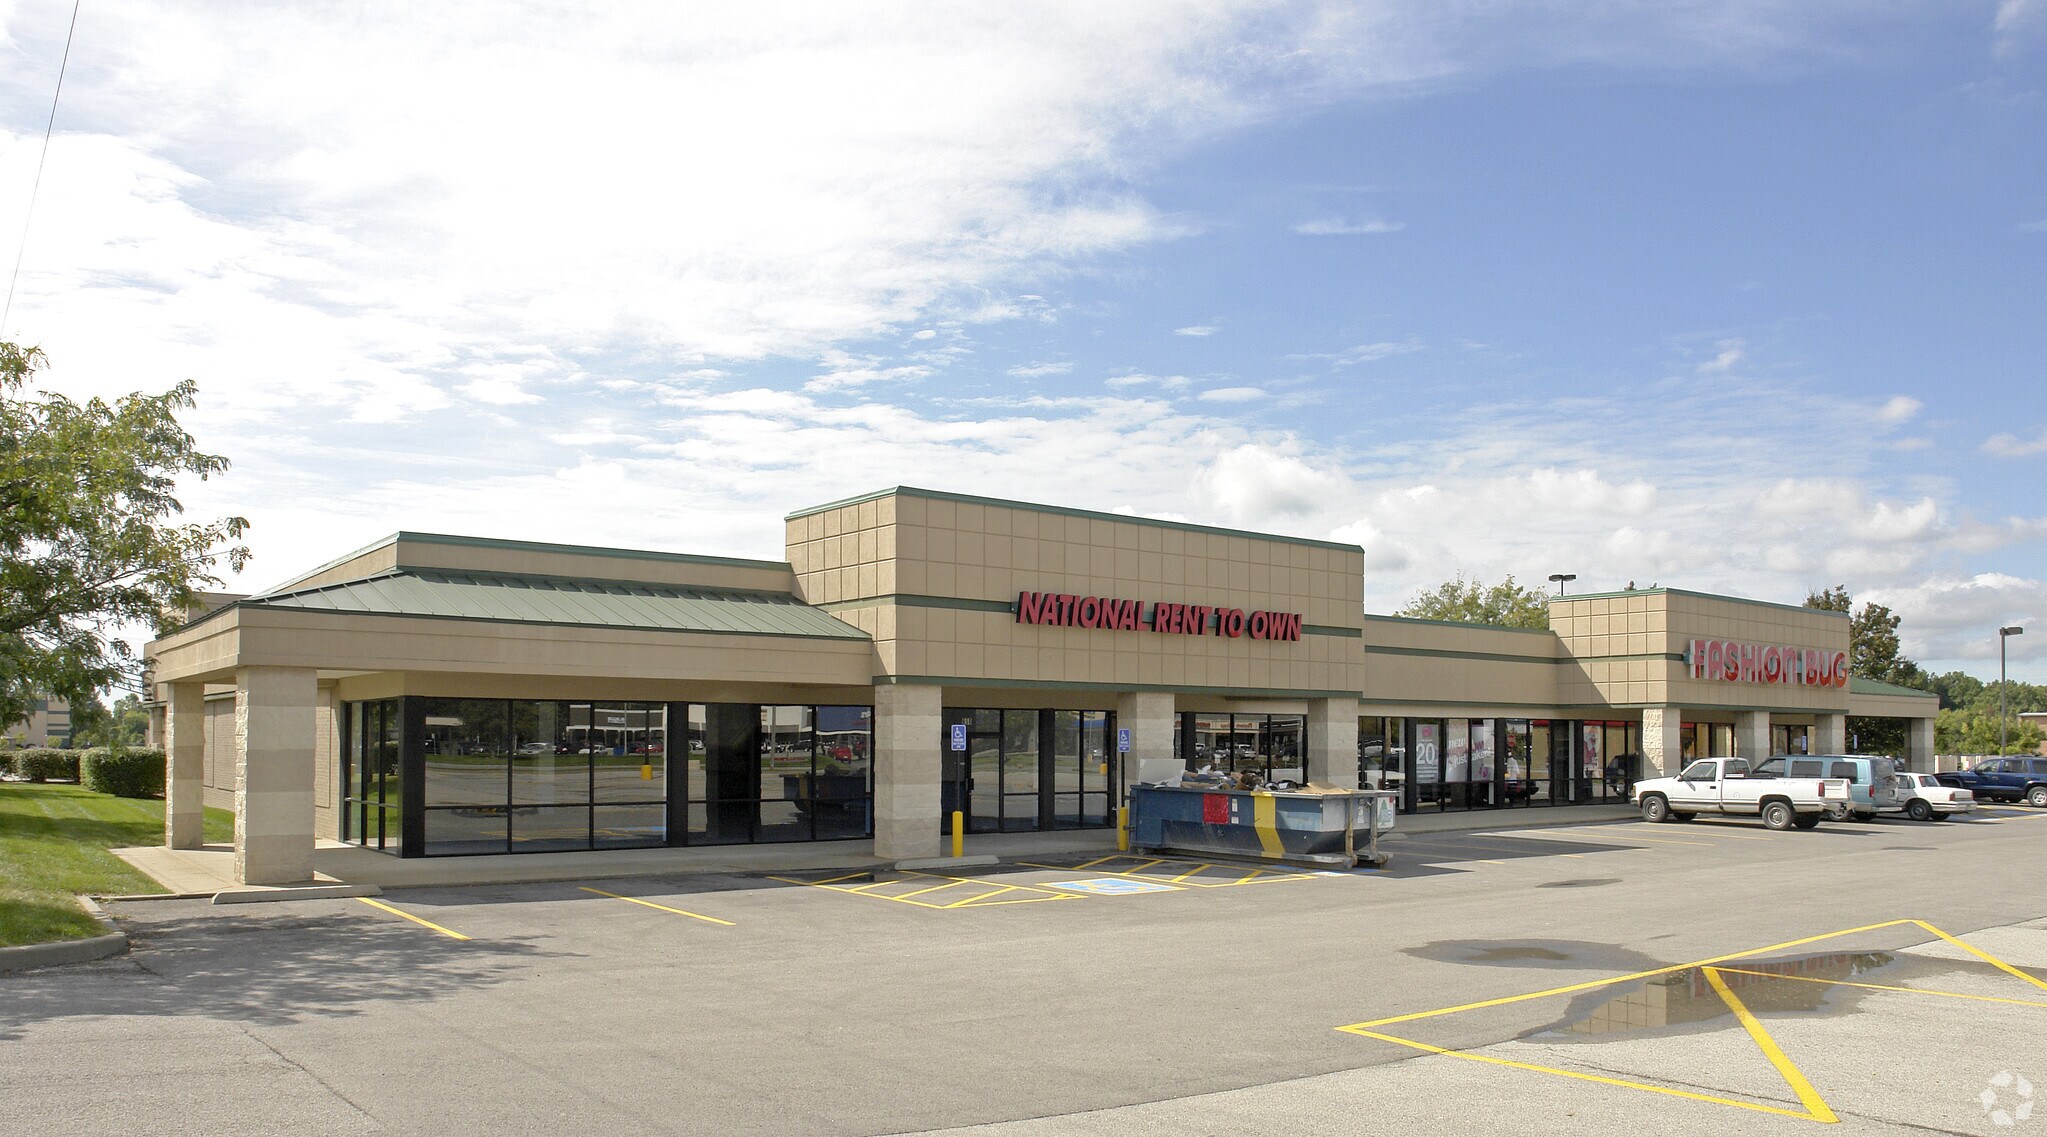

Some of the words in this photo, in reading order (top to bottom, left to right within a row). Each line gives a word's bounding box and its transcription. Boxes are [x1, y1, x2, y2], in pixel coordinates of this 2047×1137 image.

[1016, 591, 1147, 631] NATIONAL
[1152, 602, 1213, 636] RENT
[1215, 607, 1245, 638] TO
[1248, 610, 1302, 641] OWN
[1689, 639, 1798, 684] FASHION
[1801, 650, 1848, 688] BUG
[1416, 742, 1435, 765] 20
